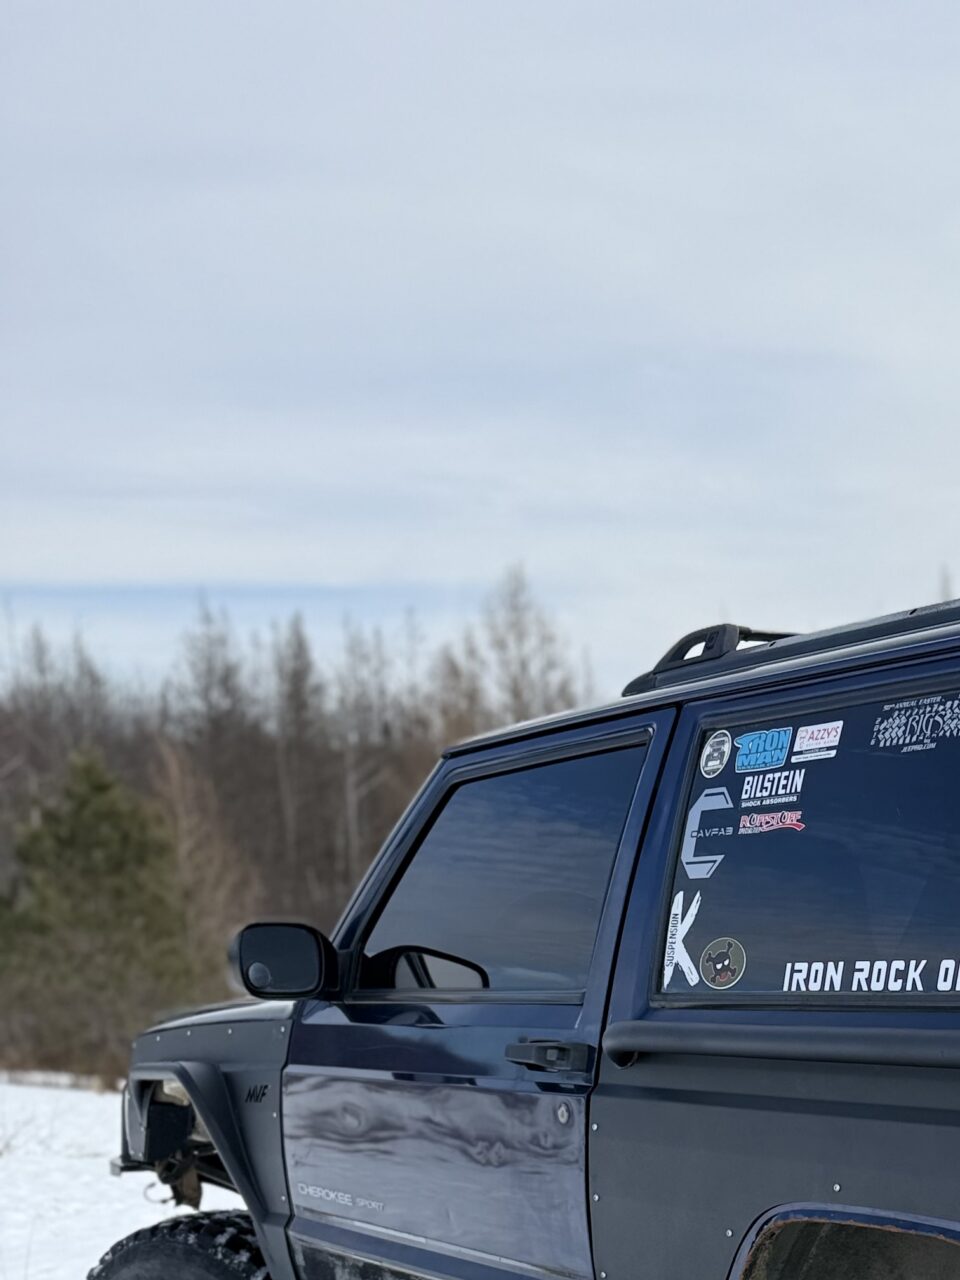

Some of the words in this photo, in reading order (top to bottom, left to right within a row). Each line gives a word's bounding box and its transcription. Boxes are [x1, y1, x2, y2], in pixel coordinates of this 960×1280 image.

[736, 730, 791, 755] IRON
[739, 748, 788, 766] MAN
[741, 769, 806, 800] BILSTEIN
[741, 799, 761, 808] SHOCK
[761, 795, 798, 805] ABSORBERS
[666, 913, 680, 968] SUSPENSION
[782, 961, 844, 992] IRON
[851, 959, 927, 992] ROCK
[298, 1183, 353, 1206] CHEROKEE
[355, 1198, 385, 1211] SPORT
